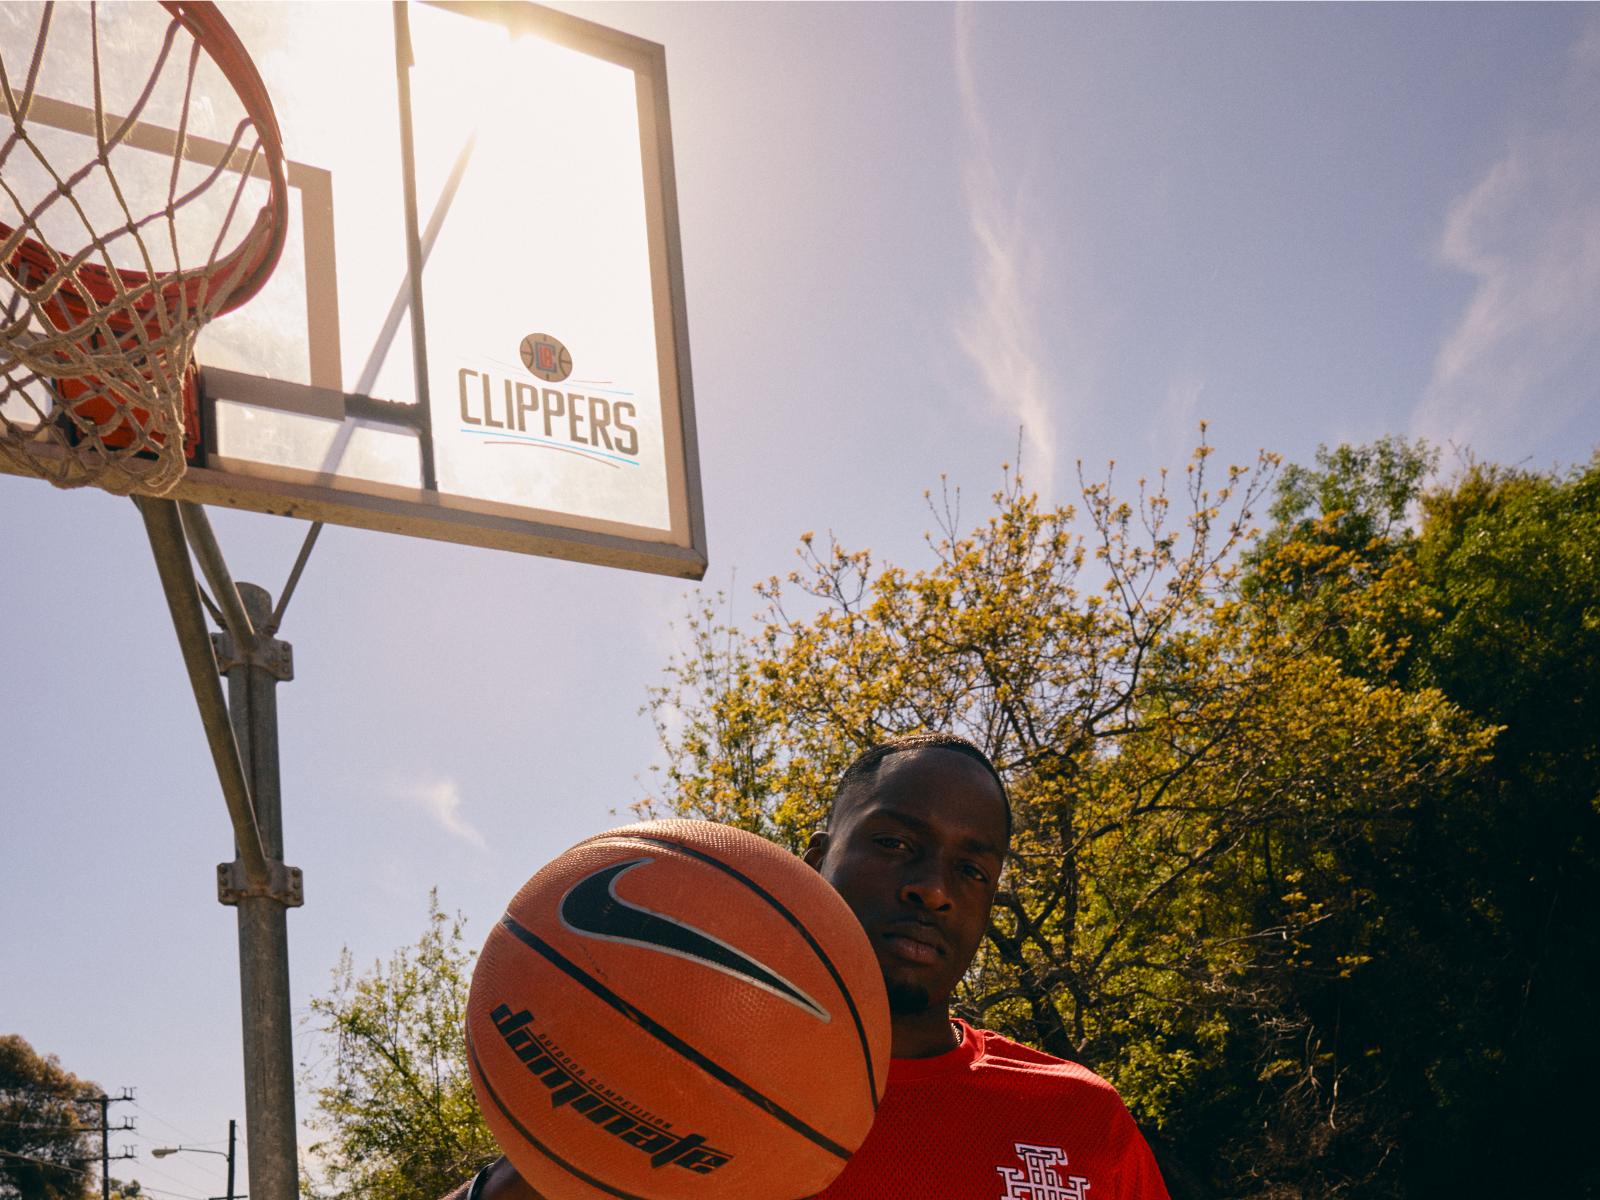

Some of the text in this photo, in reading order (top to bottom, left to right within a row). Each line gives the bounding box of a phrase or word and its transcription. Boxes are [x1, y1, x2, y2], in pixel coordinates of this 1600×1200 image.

[458, 367, 639, 456] CLIPPERS
[489, 1003, 731, 1175] dominate
[538, 1032, 674, 1130] OUTDOOR COMPETITION
